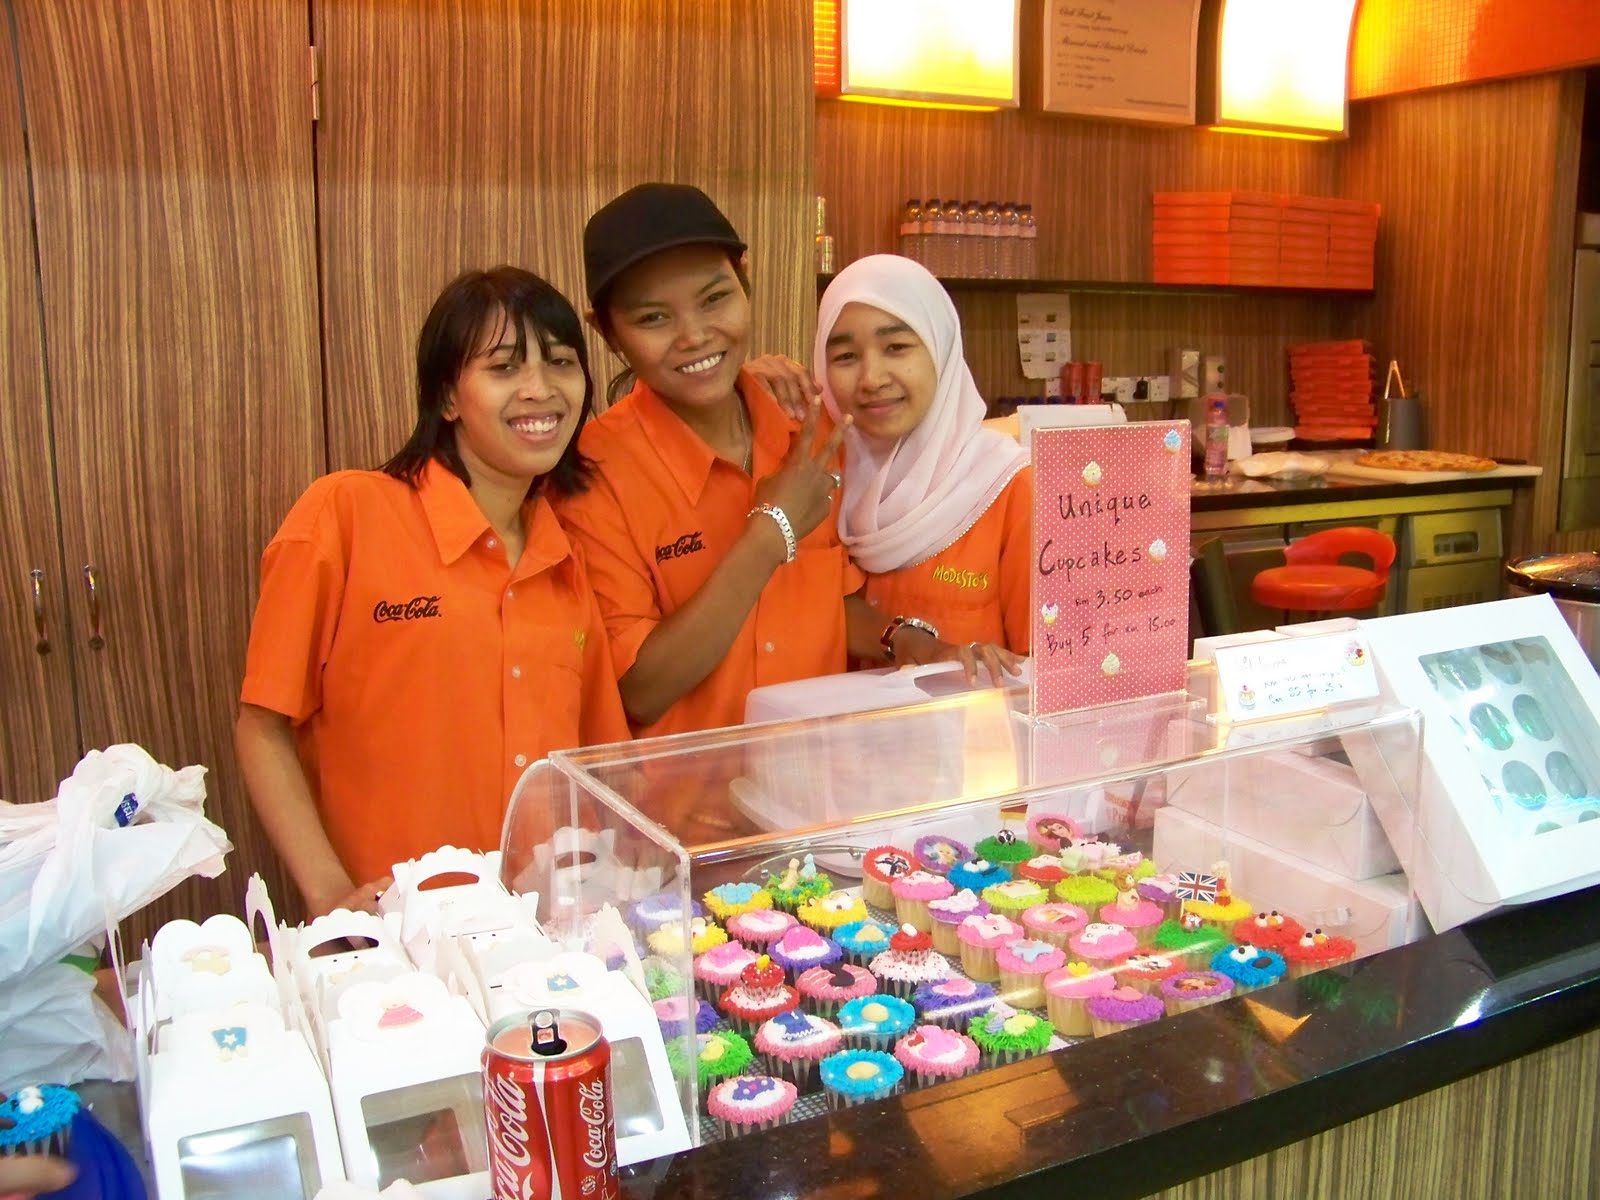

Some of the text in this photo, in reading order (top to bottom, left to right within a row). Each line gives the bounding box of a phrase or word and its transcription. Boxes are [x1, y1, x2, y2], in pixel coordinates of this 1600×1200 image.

[1058, 493, 1152, 527] Unique
[655, 531, 706, 566] oca-Cola
[1038, 539, 1142, 582] Cupcakes
[1095, 588, 1133, 609] 3.50
[1046, 633, 1072, 656] Buy
[1081, 625, 1092, 646] 5
[1102, 622, 1119, 645] for
[1148, 616, 1176, 632] 15.00
[578, 1077, 608, 1168] Coca-Cola
